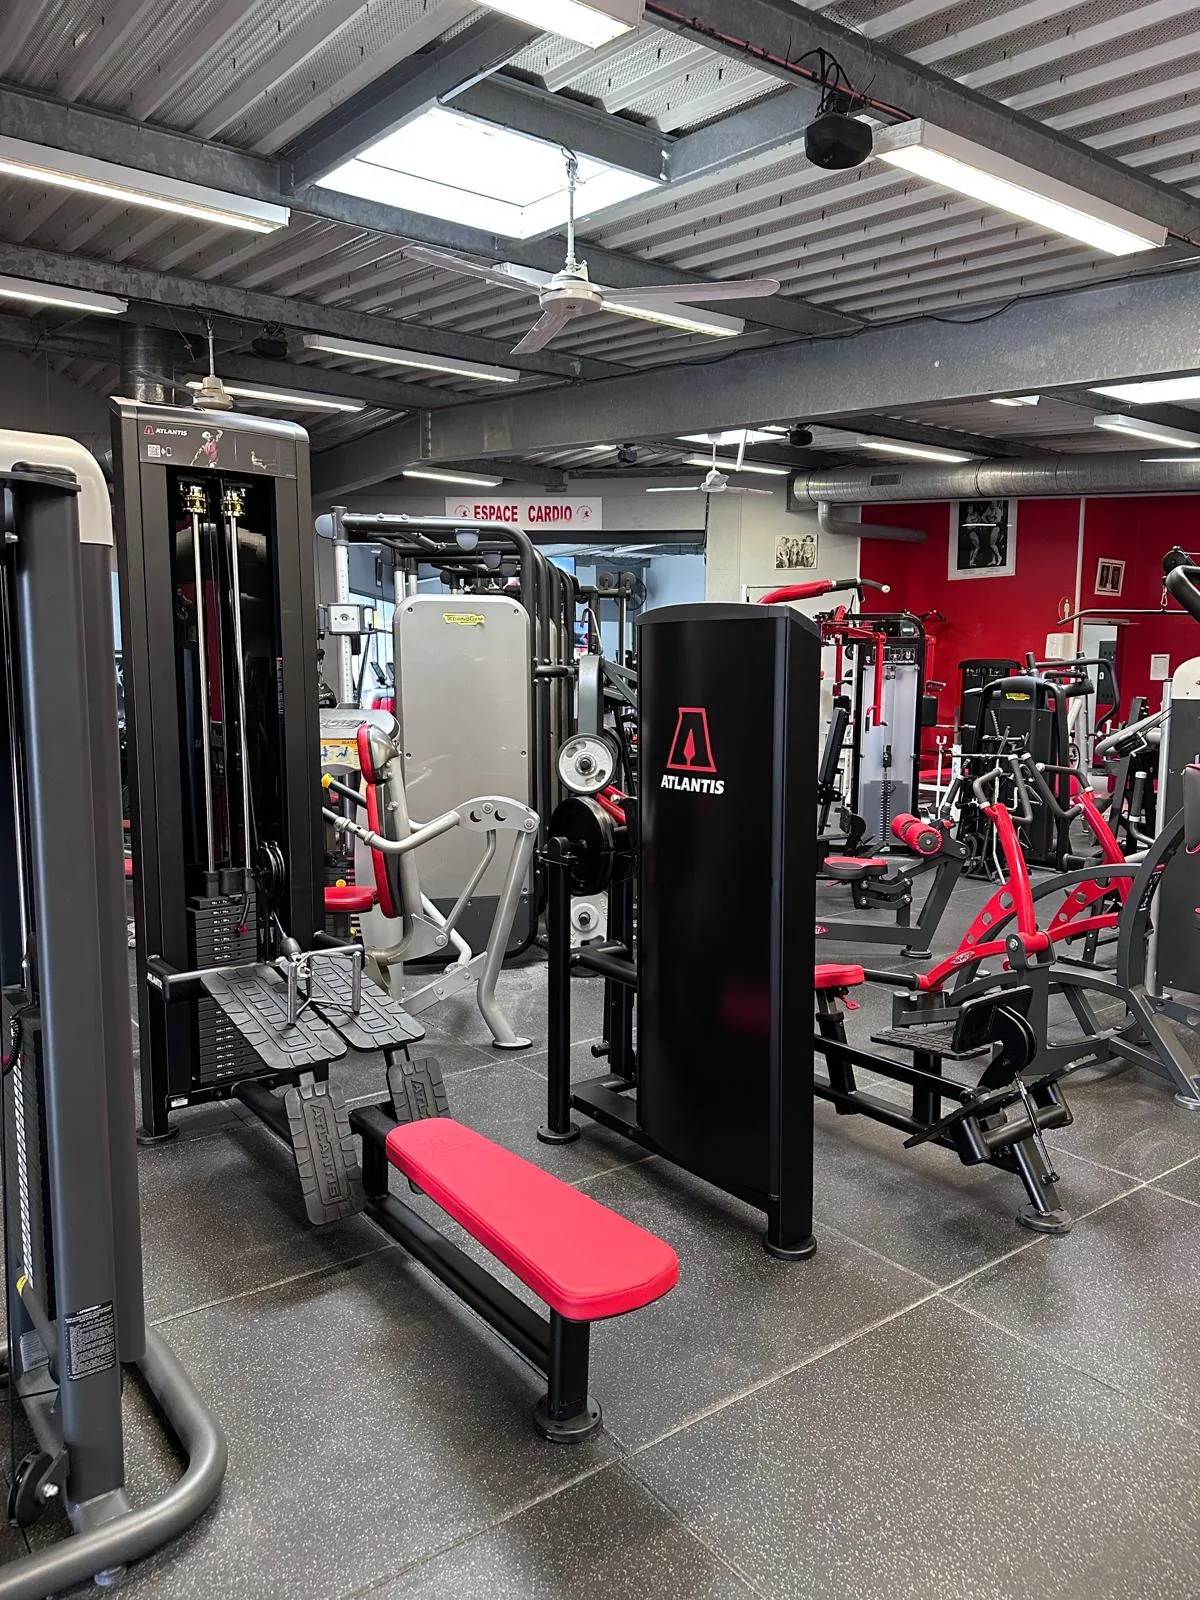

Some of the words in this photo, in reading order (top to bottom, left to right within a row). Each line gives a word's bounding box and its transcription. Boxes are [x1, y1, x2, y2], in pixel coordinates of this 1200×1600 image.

[155, 427, 188, 437] ATLANTIS
[473, 505, 519, 523] ESPACE
[527, 505, 573, 523] CARDIO
[660, 774, 725, 795] ATLANTIS
[310, 1106, 340, 1198] ATLANTIS
